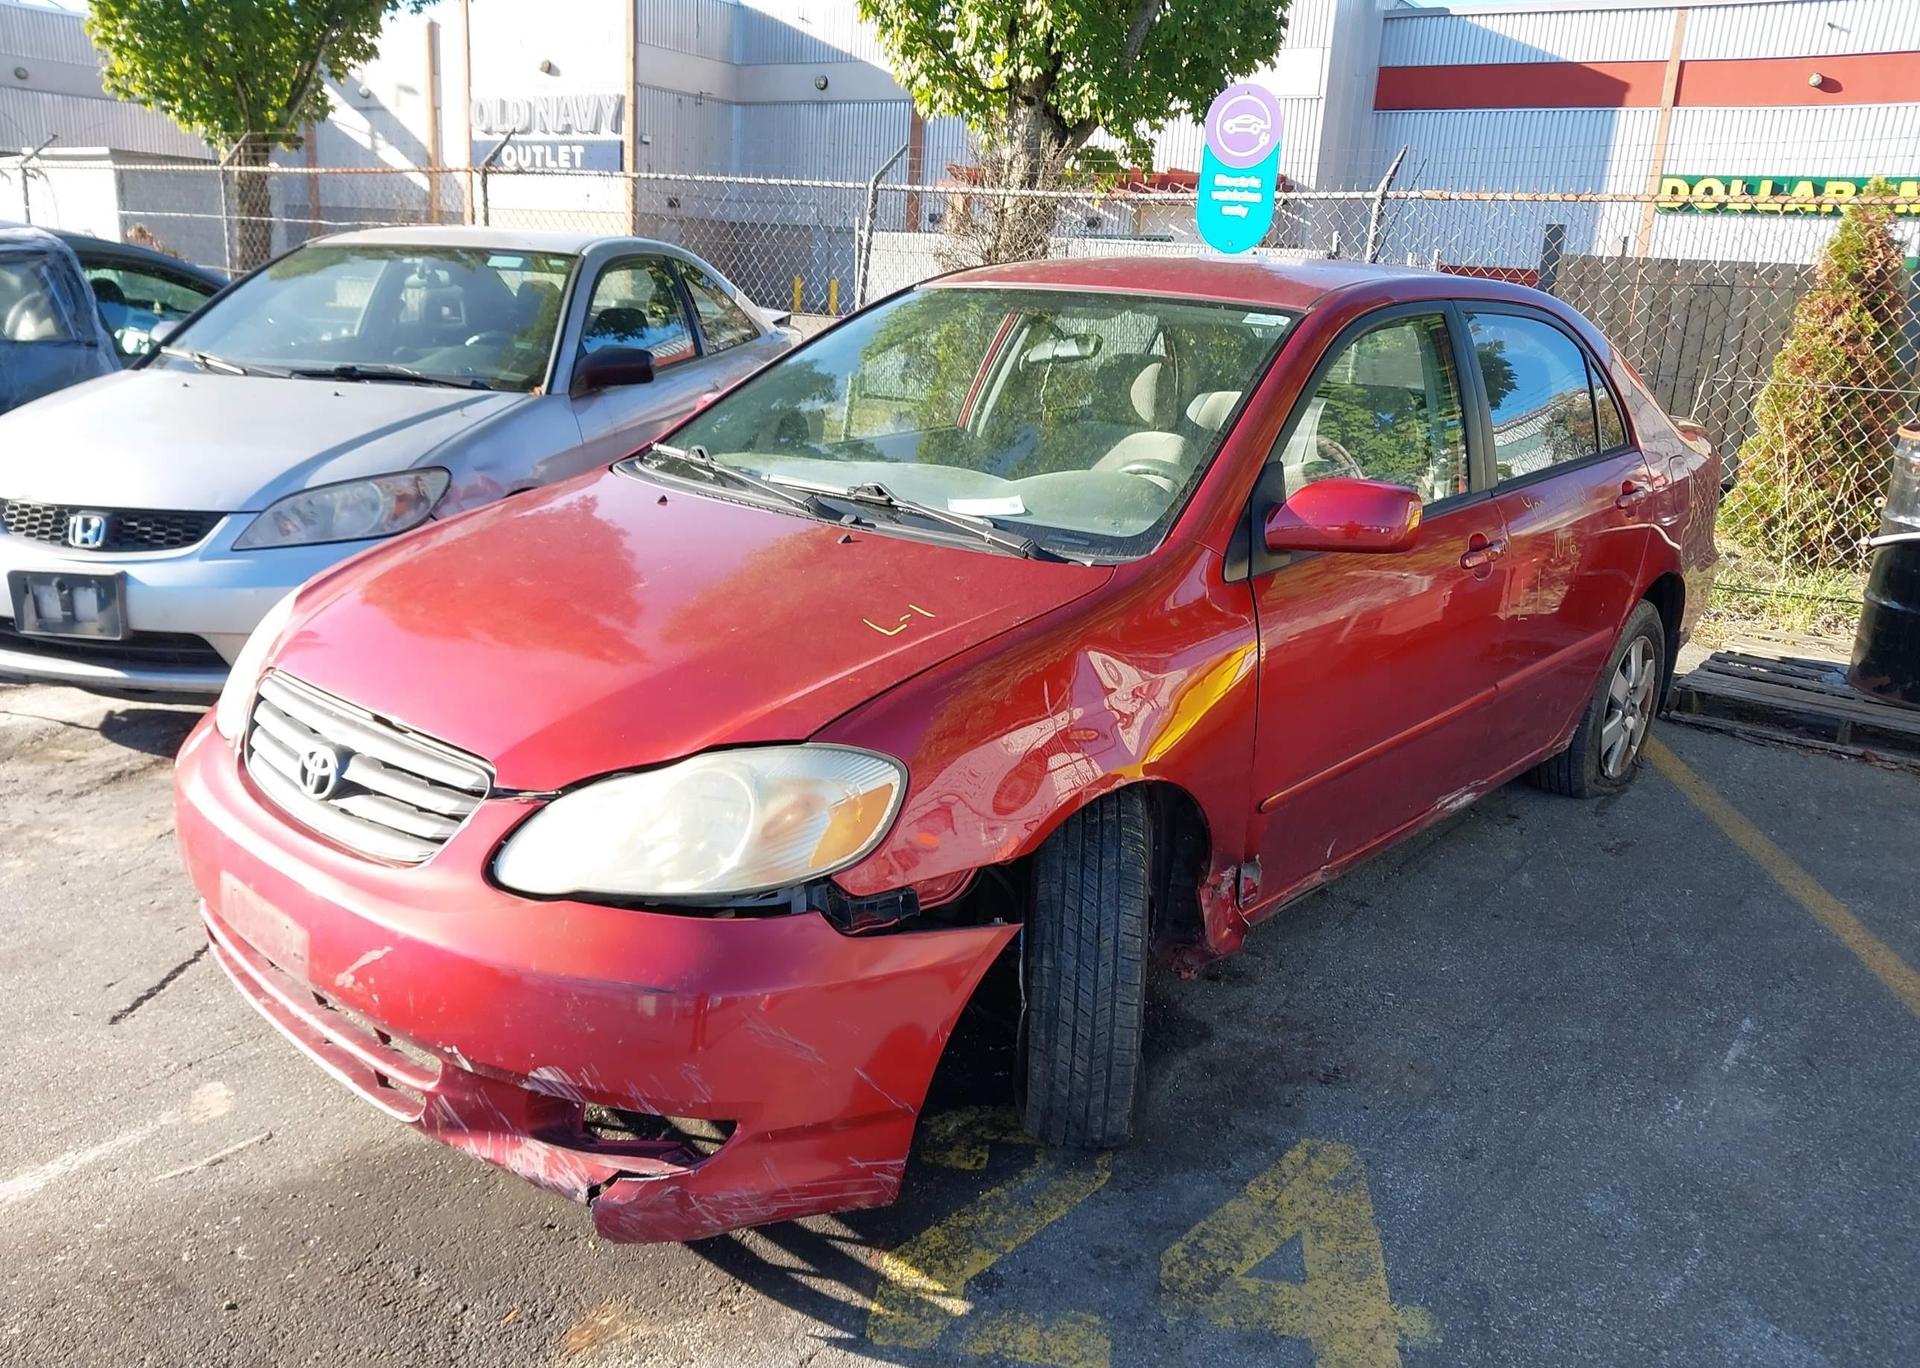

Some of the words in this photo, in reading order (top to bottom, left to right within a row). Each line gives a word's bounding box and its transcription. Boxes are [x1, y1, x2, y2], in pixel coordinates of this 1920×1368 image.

[472, 97, 530, 135] OLD
[532, 94, 622, 134] NAVY
[501, 145, 584, 168] OUTLET
